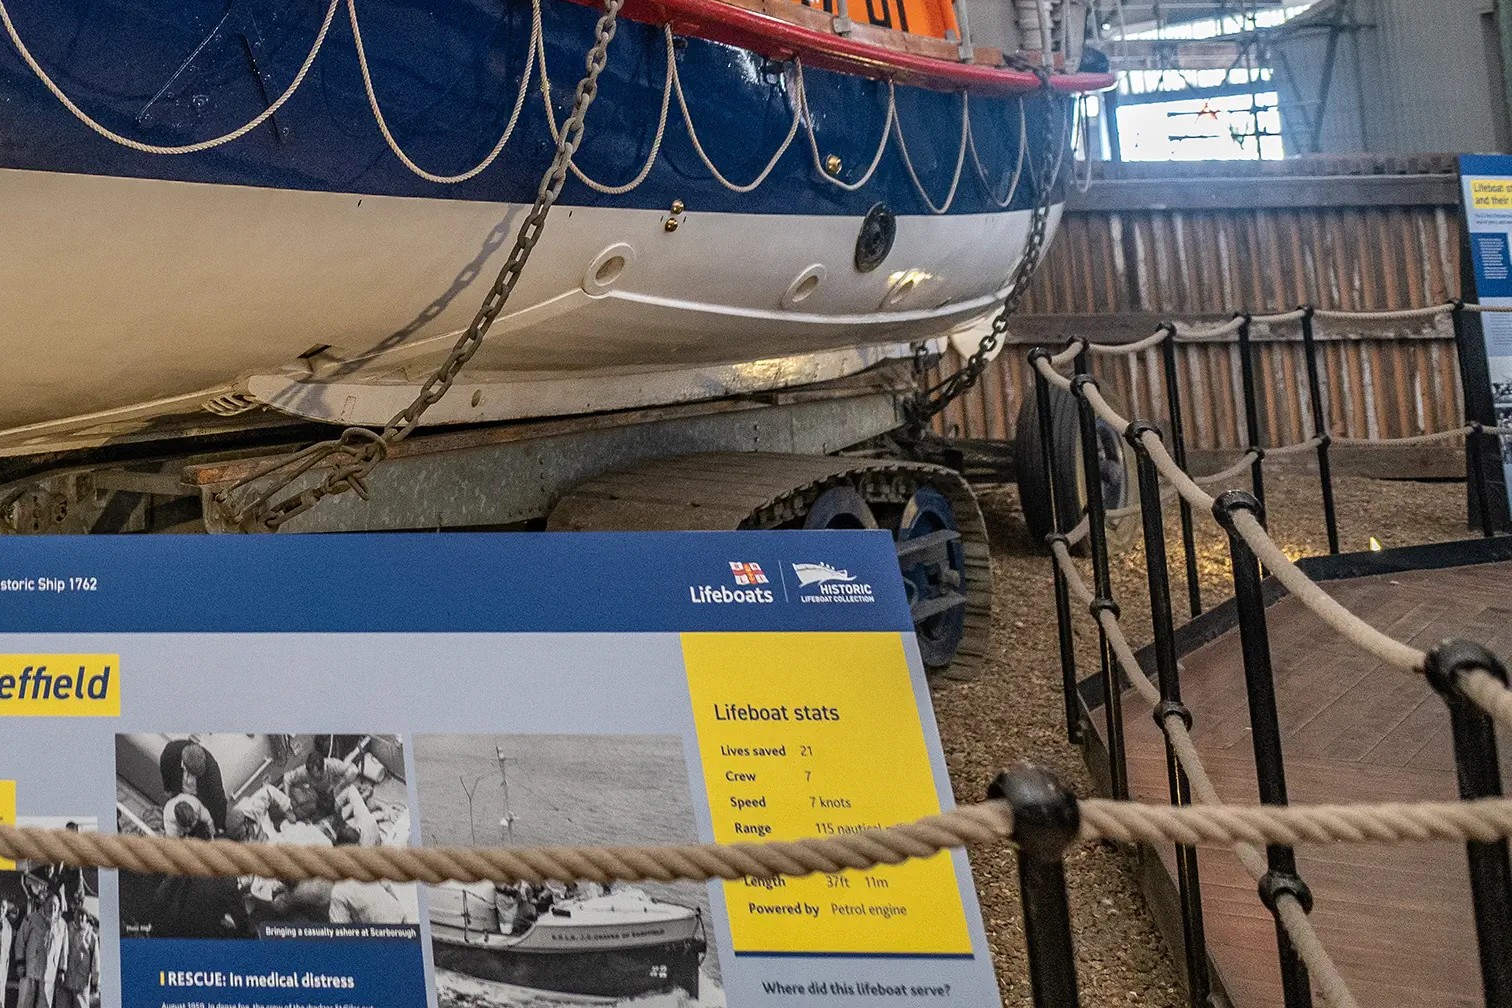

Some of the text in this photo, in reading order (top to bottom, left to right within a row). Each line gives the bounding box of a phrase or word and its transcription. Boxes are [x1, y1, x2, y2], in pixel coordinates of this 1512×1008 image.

[38, 577, 65, 594] Ship
[69, 577, 97, 592] 1762
[820, 584, 872, 595] HISTORIC
[690, 586, 774, 603] Lifeboats
[714, 704, 840, 721] Lifeboat stats
[721, 745, 813, 756] Lives saved 21
[726, 771, 812, 782] Crew 7
[730, 796, 851, 810] Speed 7 knots
[734, 822, 772, 837] Range
[816, 822, 834, 834] 115
[743, 875, 888, 890] Length 37ft 11m
[749, 902, 907, 918] Powered by Petrol engine
[265, 926, 296, 938] Bringing
[304, 926, 334, 939] casualty
[335, 927, 360, 937] ashore
[362, 928, 369, 937] at
[370, 927, 417, 939] Scarborough
[168, 971, 355, 989] RESCUE: In medical distress
[762, 981, 951, 997] Where did this lifeboat serve?
